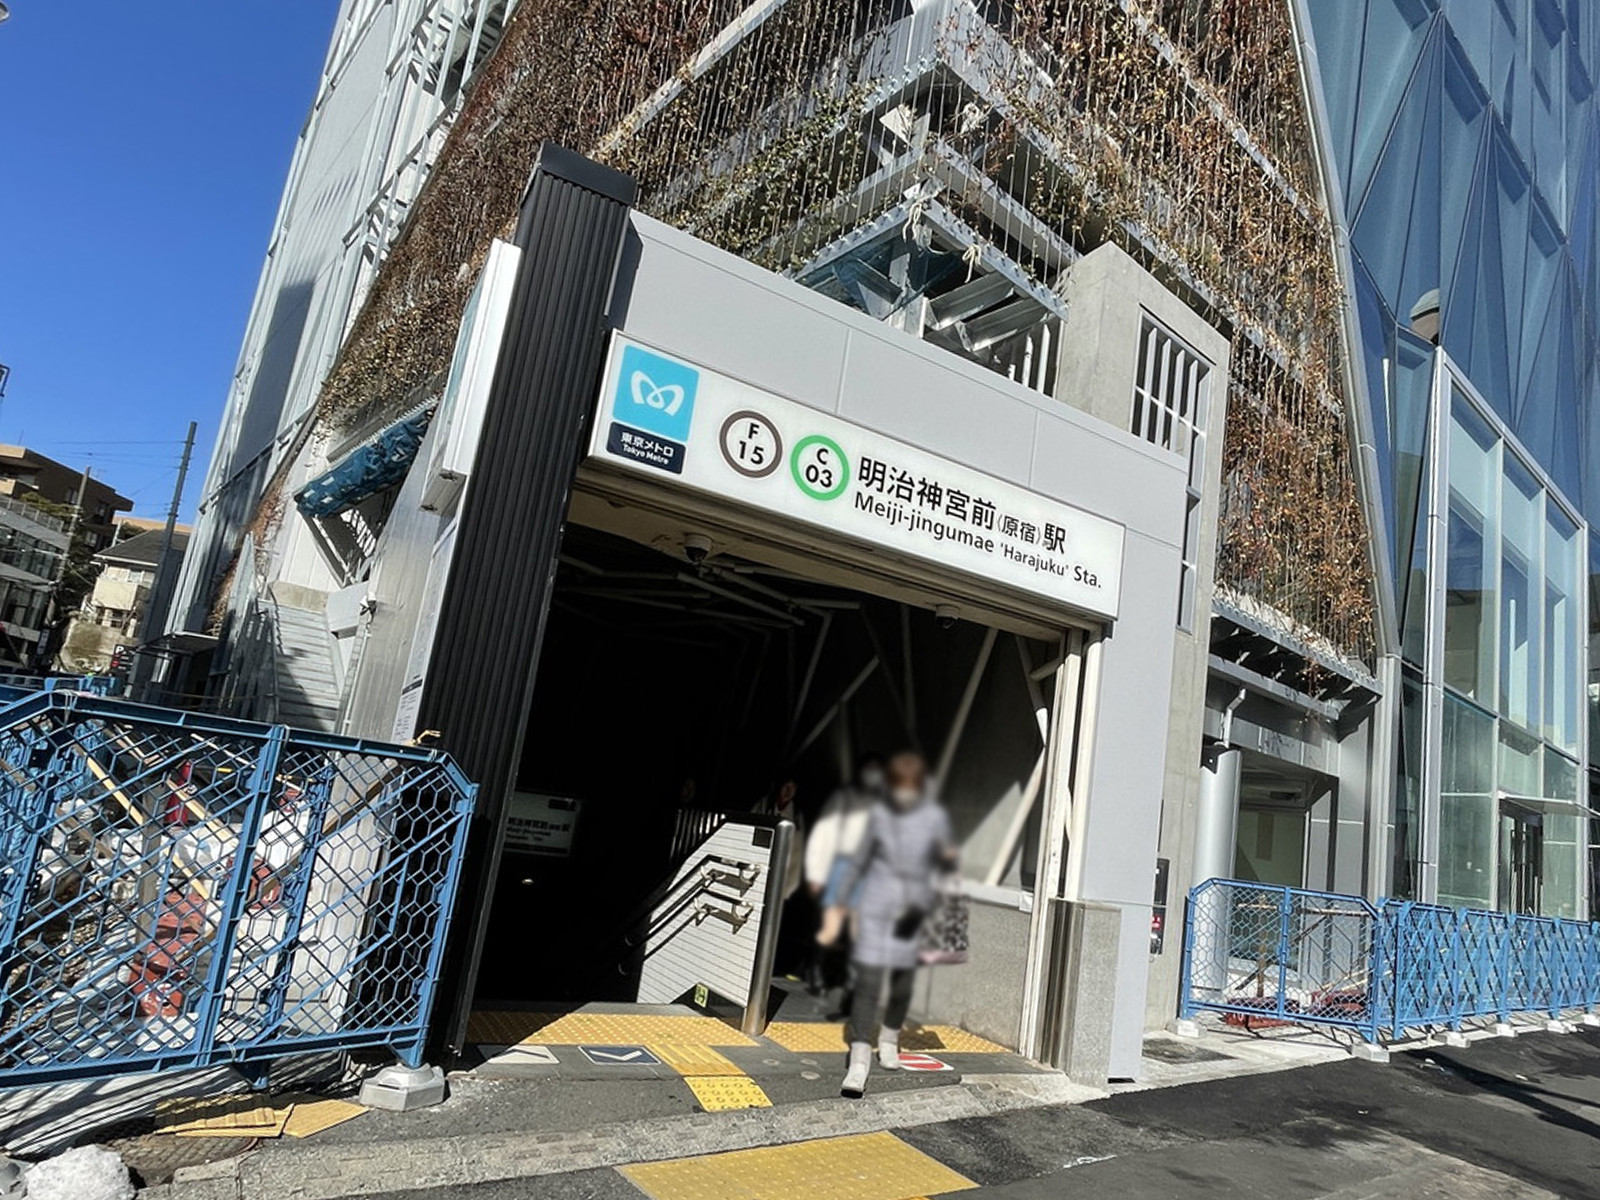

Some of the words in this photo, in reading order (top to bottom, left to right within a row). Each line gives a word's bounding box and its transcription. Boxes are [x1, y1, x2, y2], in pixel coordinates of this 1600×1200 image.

[748, 422, 761, 440] F
[621, 432, 674, 457] 東京メトロ
[622, 443, 647, 458] Tokyo
[645, 452, 670, 466] Metro
[737, 440, 765, 465] 15
[816, 448, 829, 465] C
[805, 464, 833, 488] 03
[855, 491, 994, 552] Meiji-jingumae
[1074, 565, 1102, 589] Sta.
